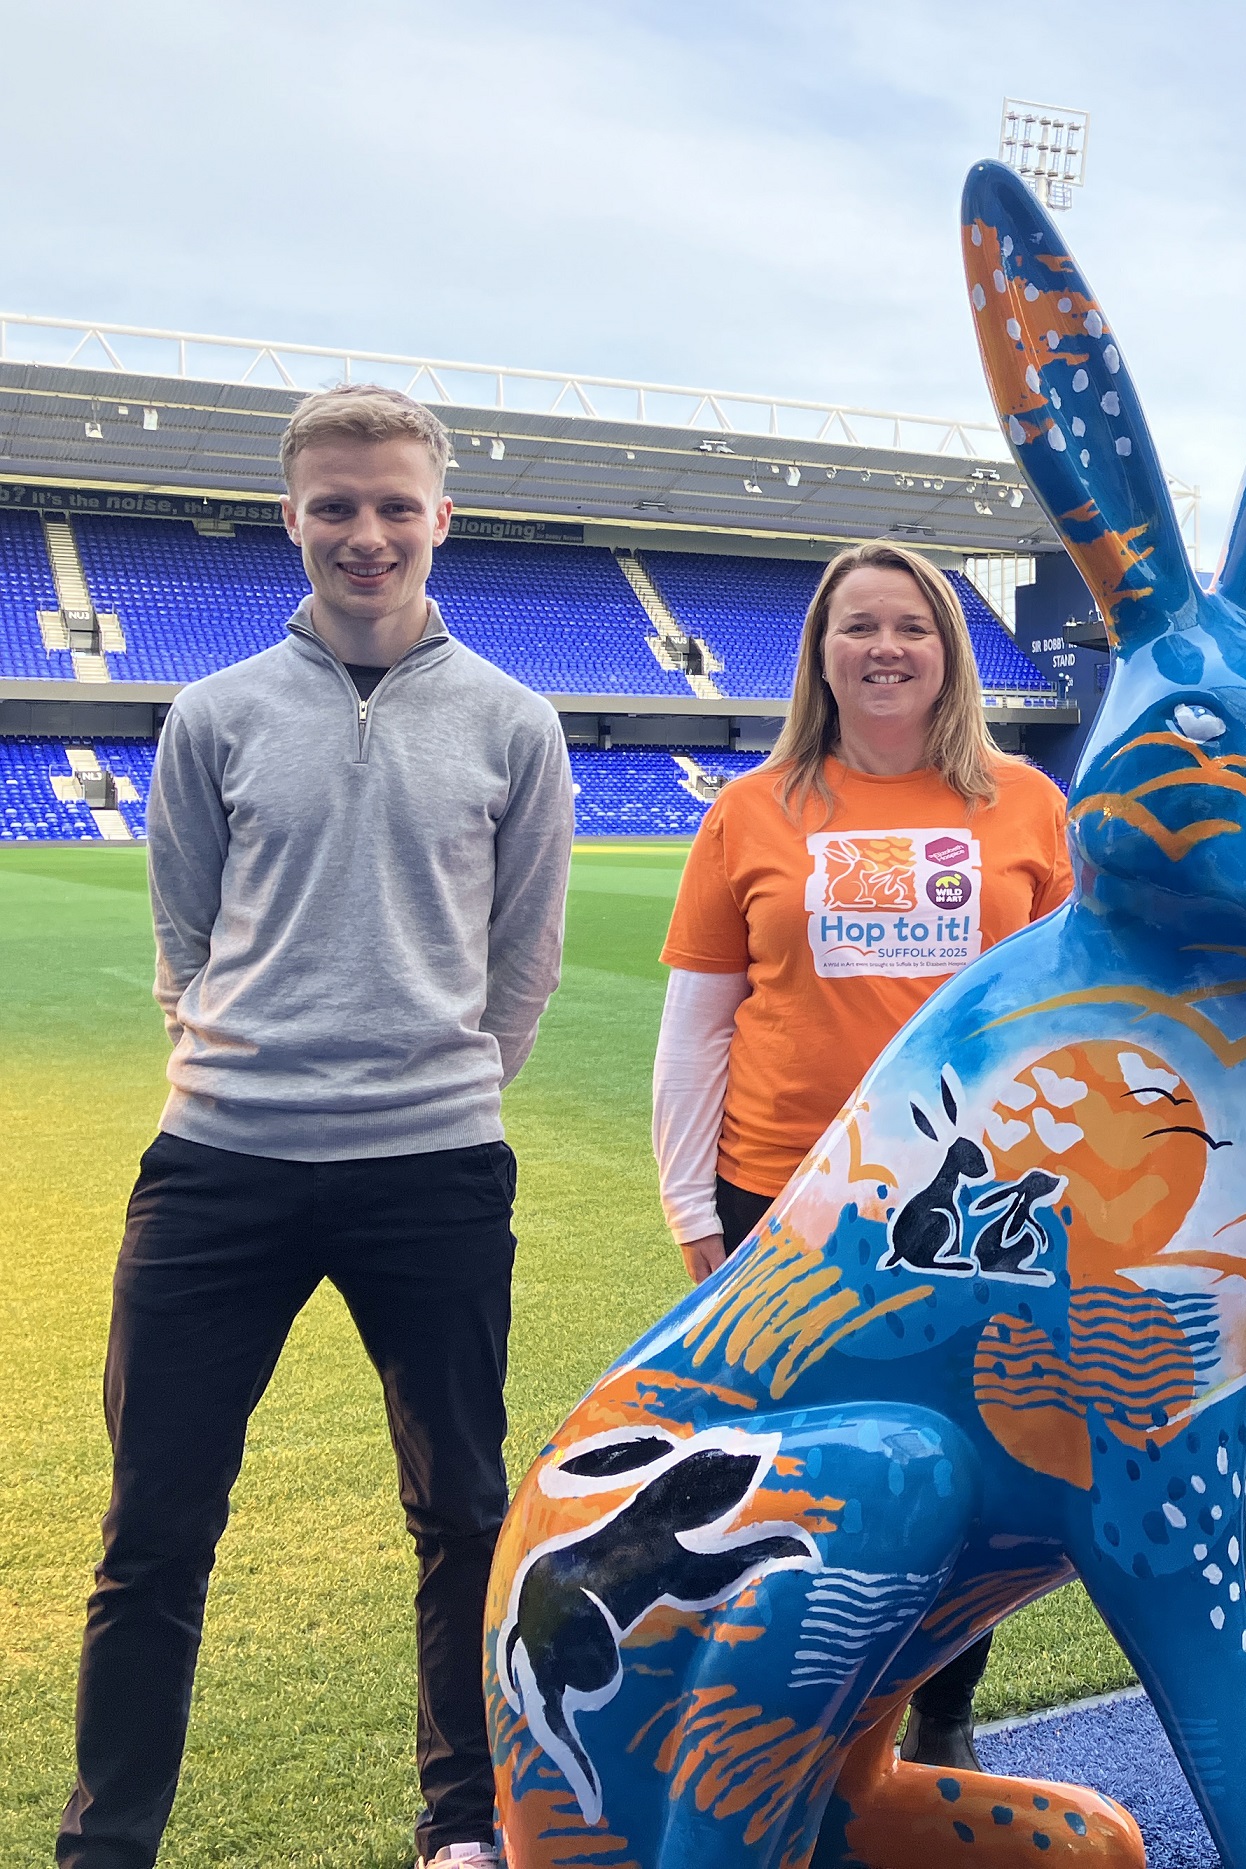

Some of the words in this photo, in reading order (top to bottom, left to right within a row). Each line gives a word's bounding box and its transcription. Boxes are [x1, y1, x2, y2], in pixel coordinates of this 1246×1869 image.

[69, 494, 100, 508] the
[106, 494, 177, 514] noise,
[219, 505, 284, 520] passi
[69, 611, 90, 620] NU3
[1031, 640, 1041, 653] SIR
[1052, 653, 1076, 668] STAND
[935, 888, 963, 896] WILD
[821, 916, 885, 947] Hop
[893, 917, 929, 941] to
[937, 916, 970, 941] it!
[878, 948, 936, 957] SUFFOLK
[940, 948, 968, 957] 2025
